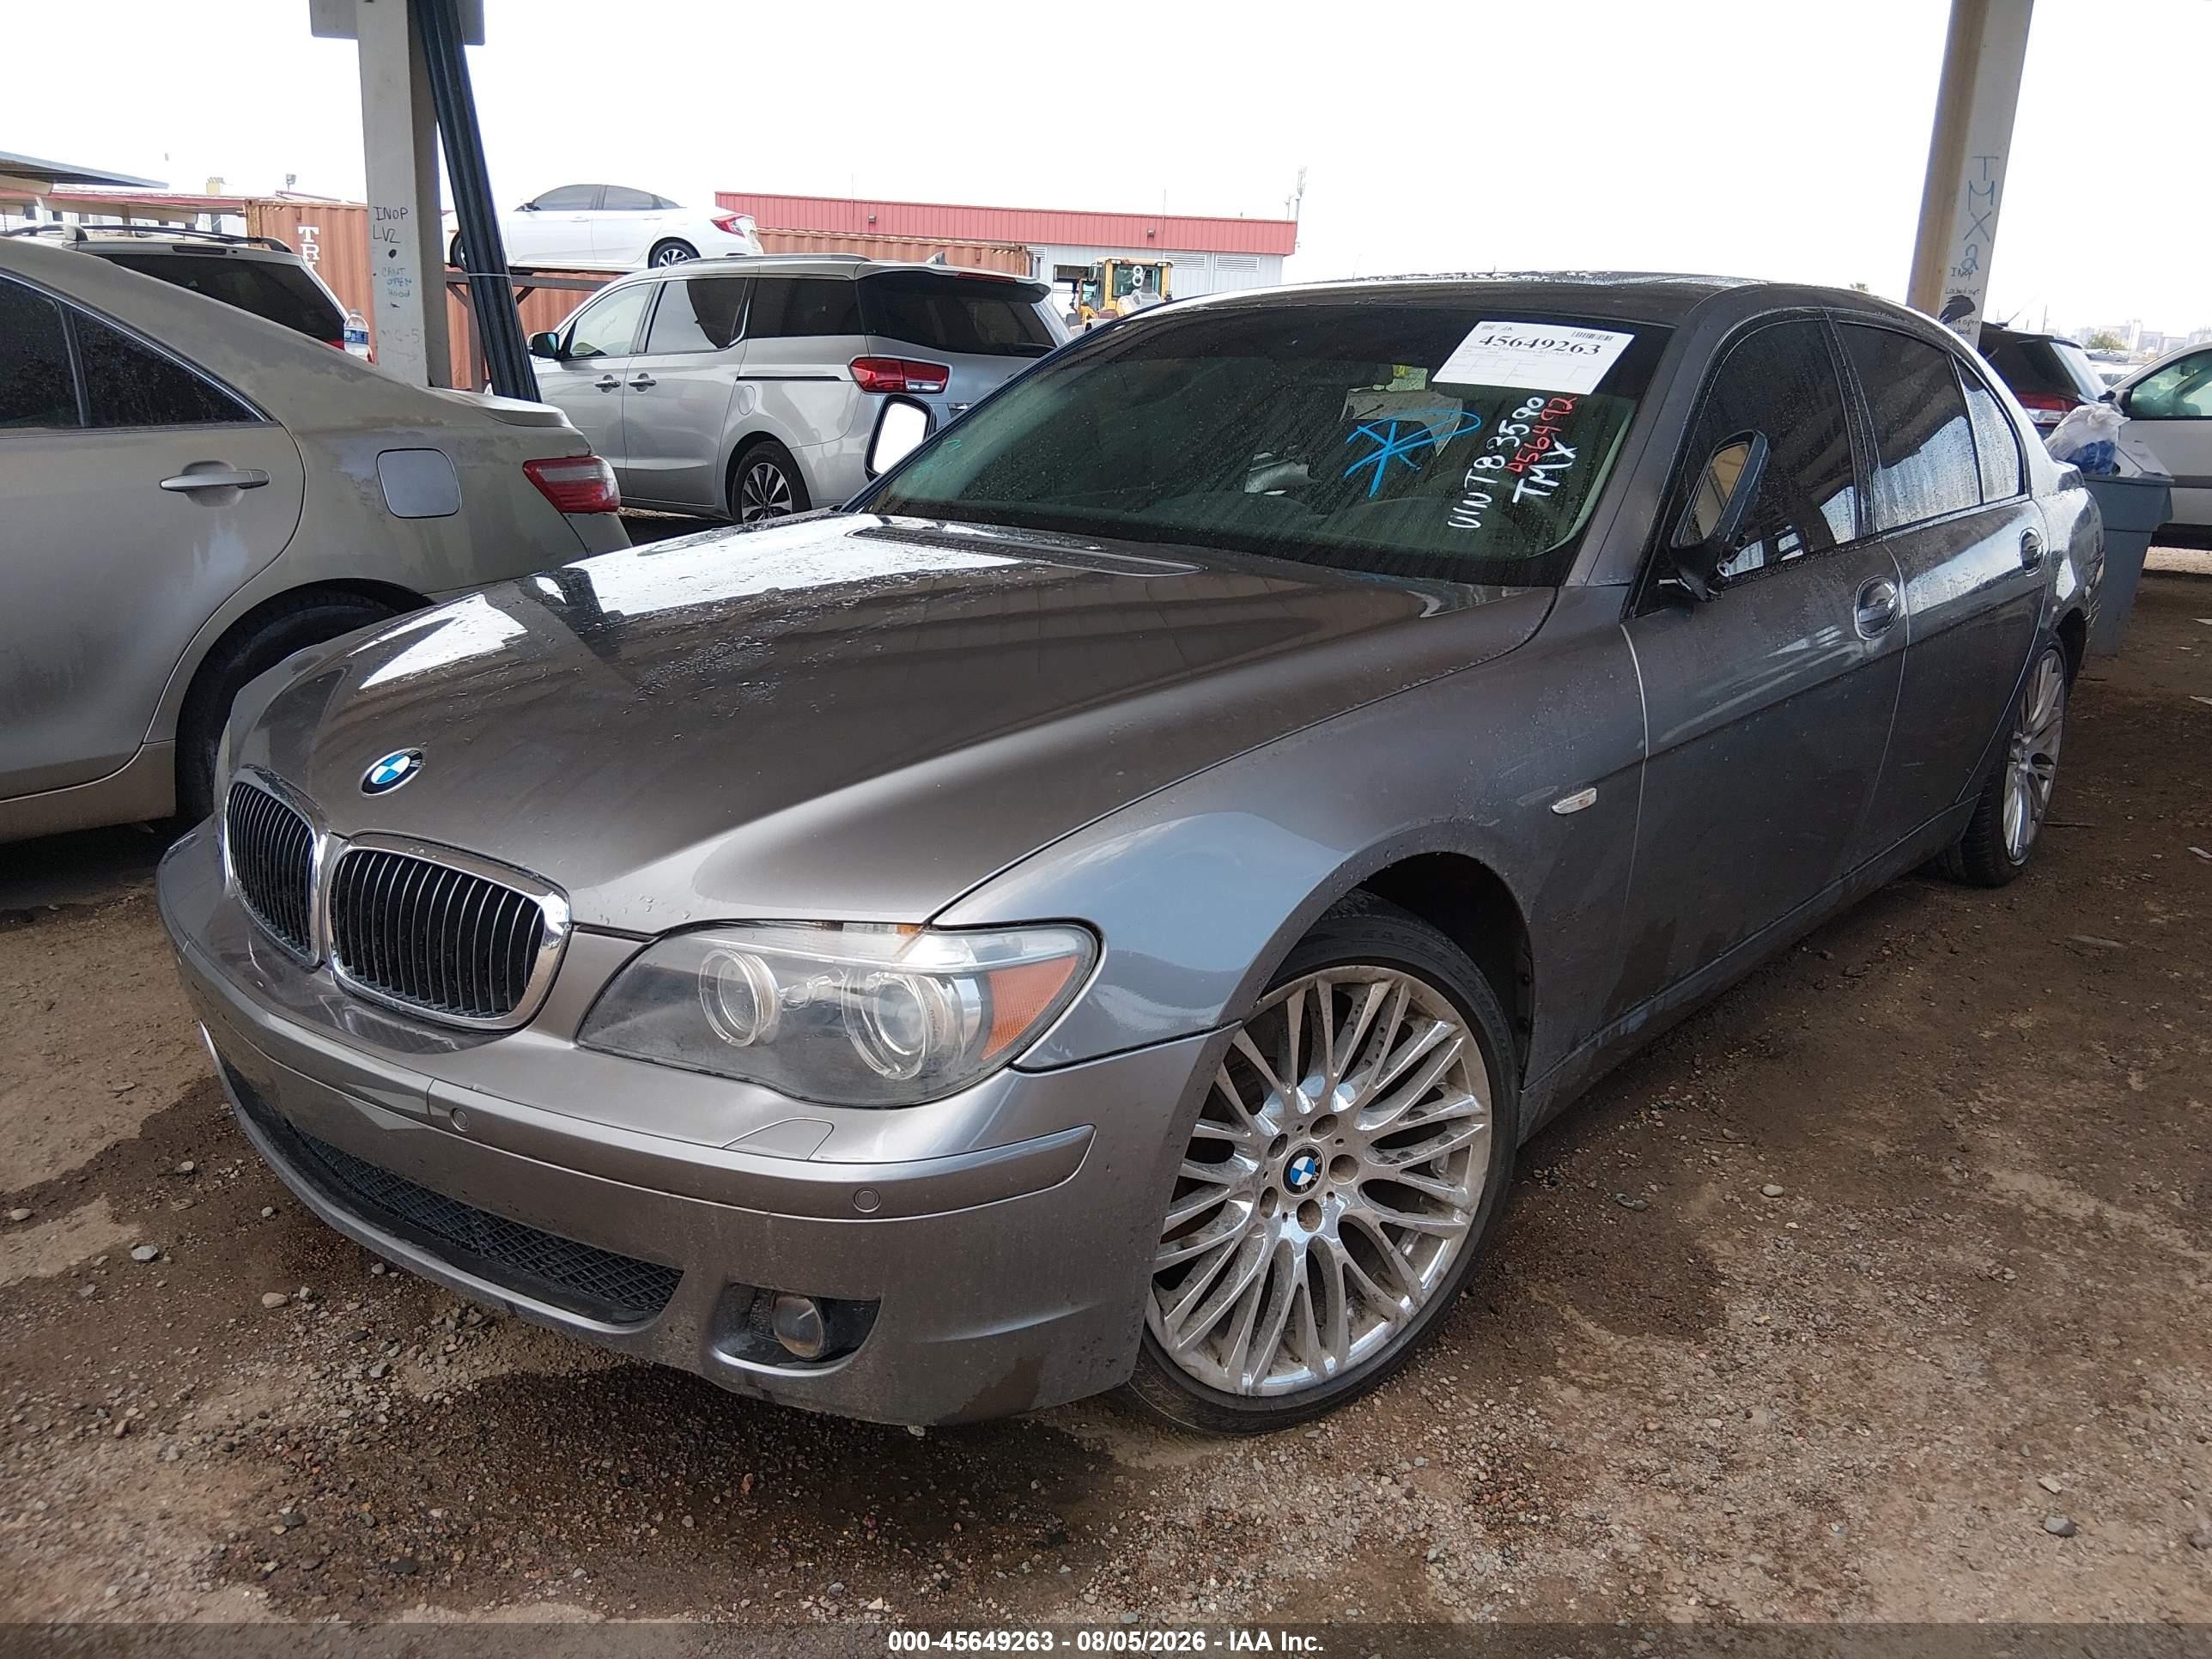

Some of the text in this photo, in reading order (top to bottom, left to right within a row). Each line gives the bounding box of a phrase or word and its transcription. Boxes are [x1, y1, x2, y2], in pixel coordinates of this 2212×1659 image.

[374, 206, 409, 221] INOP
[1132, 264, 1144, 287] 8
[1478, 334, 1602, 356] 45649263
[1511, 432, 1578, 503] TMX
